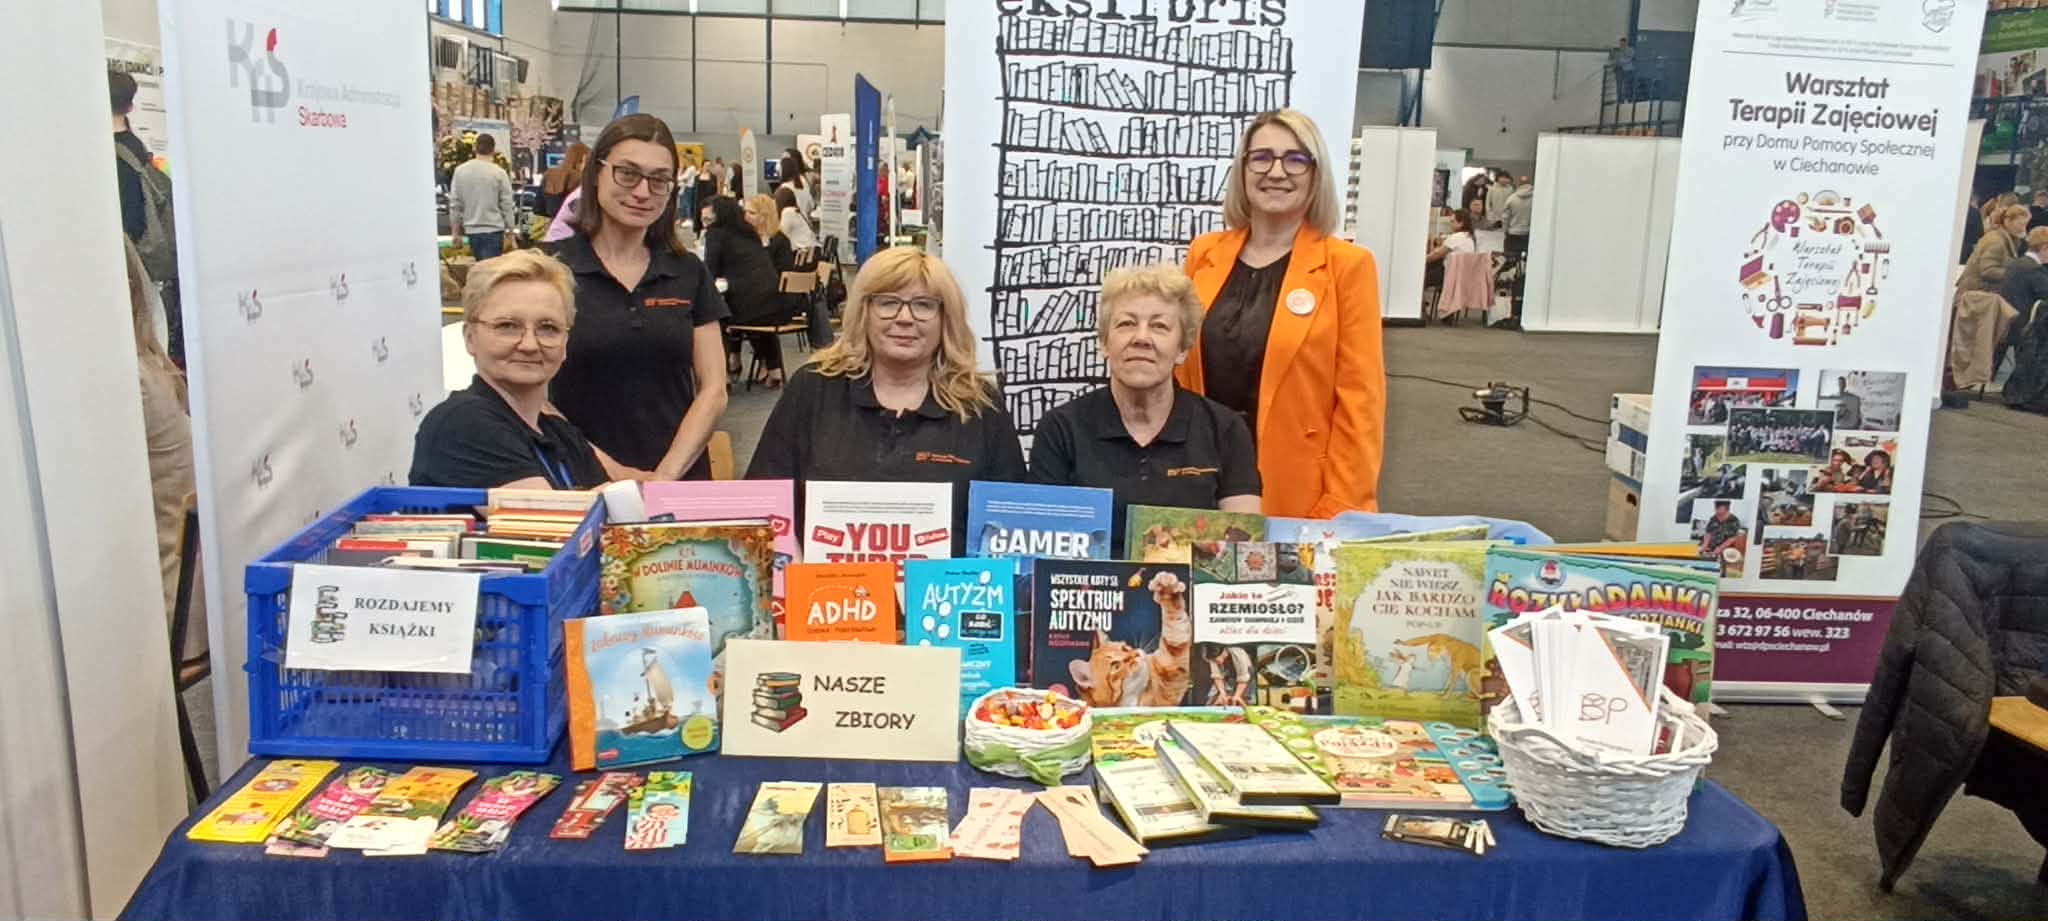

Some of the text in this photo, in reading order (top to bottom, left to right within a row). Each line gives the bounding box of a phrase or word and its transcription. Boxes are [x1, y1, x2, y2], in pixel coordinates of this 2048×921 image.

[1786, 72, 1890, 99] Warsztat
[297, 104, 347, 128] Skarbowa
[1729, 98, 1938, 138] Terapii Zajęciowej
[1723, 134, 1935, 160] przy Domu Pomocy Społecznej
[1773, 157, 1880, 176] w Ciechanowie
[846, 522, 911, 552] YOU
[990, 527, 1090, 558] GAMER
[1050, 573, 1089, 585] WSZYSTKIE
[1090, 575, 1109, 586] KOTY
[1402, 566, 1449, 578] NAWET
[1389, 579, 1414, 589] NIE
[354, 597, 456, 613] ROZDAJEMY
[922, 581, 1003, 612] AUTYZM
[1050, 588, 1124, 611] SPEKTRUM
[1219, 591, 1263, 600] Jakie to
[1377, 590, 1476, 604] JAK BARDZO
[807, 597, 878, 625] ADHD
[1209, 603, 1305, 615] RZEMIOSŁO?
[1405, 605, 1476, 618] KOCHAM
[1755, 607, 1800, 620] 06-400
[1803, 608, 1874, 622] Ciechanów
[369, 621, 435, 638] KSIĄŻKI
[1048, 610, 1112, 632] AUTYZMU
[1727, 625, 1752, 637] 672
[1755, 625, 1772, 637] 97
[1773, 626, 1790, 637] 56
[1825, 627, 1850, 640] 323
[813, 675, 887, 694] NASZE
[834, 711, 916, 730] ZBIORY
